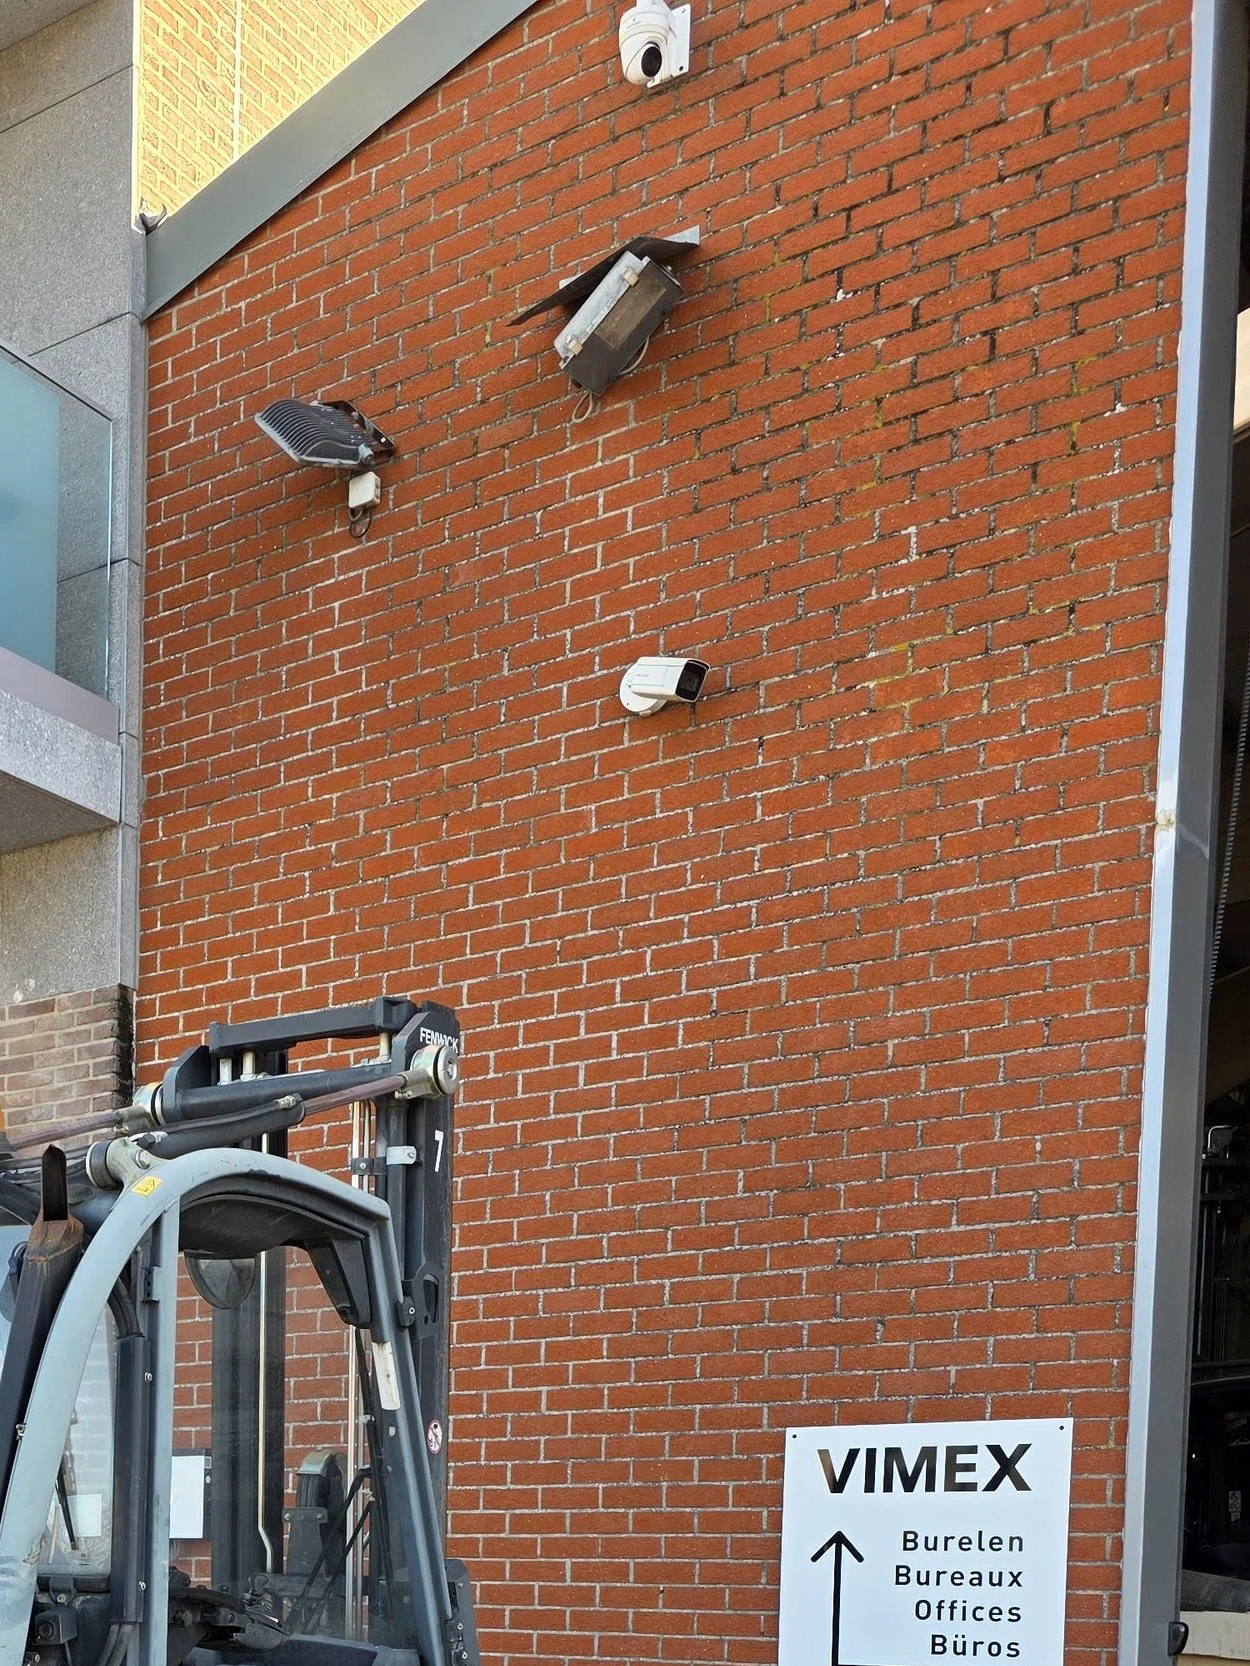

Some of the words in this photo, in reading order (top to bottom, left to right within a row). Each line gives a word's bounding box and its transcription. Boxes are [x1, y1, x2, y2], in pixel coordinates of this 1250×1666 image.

[816, 1442, 1033, 1494] VIMEX
[902, 1530, 1024, 1552] Burelen
[894, 1564, 1023, 1588] Bureaux
[914, 1599, 1022, 1623] Offices
[930, 1633, 1021, 1658] Büros
